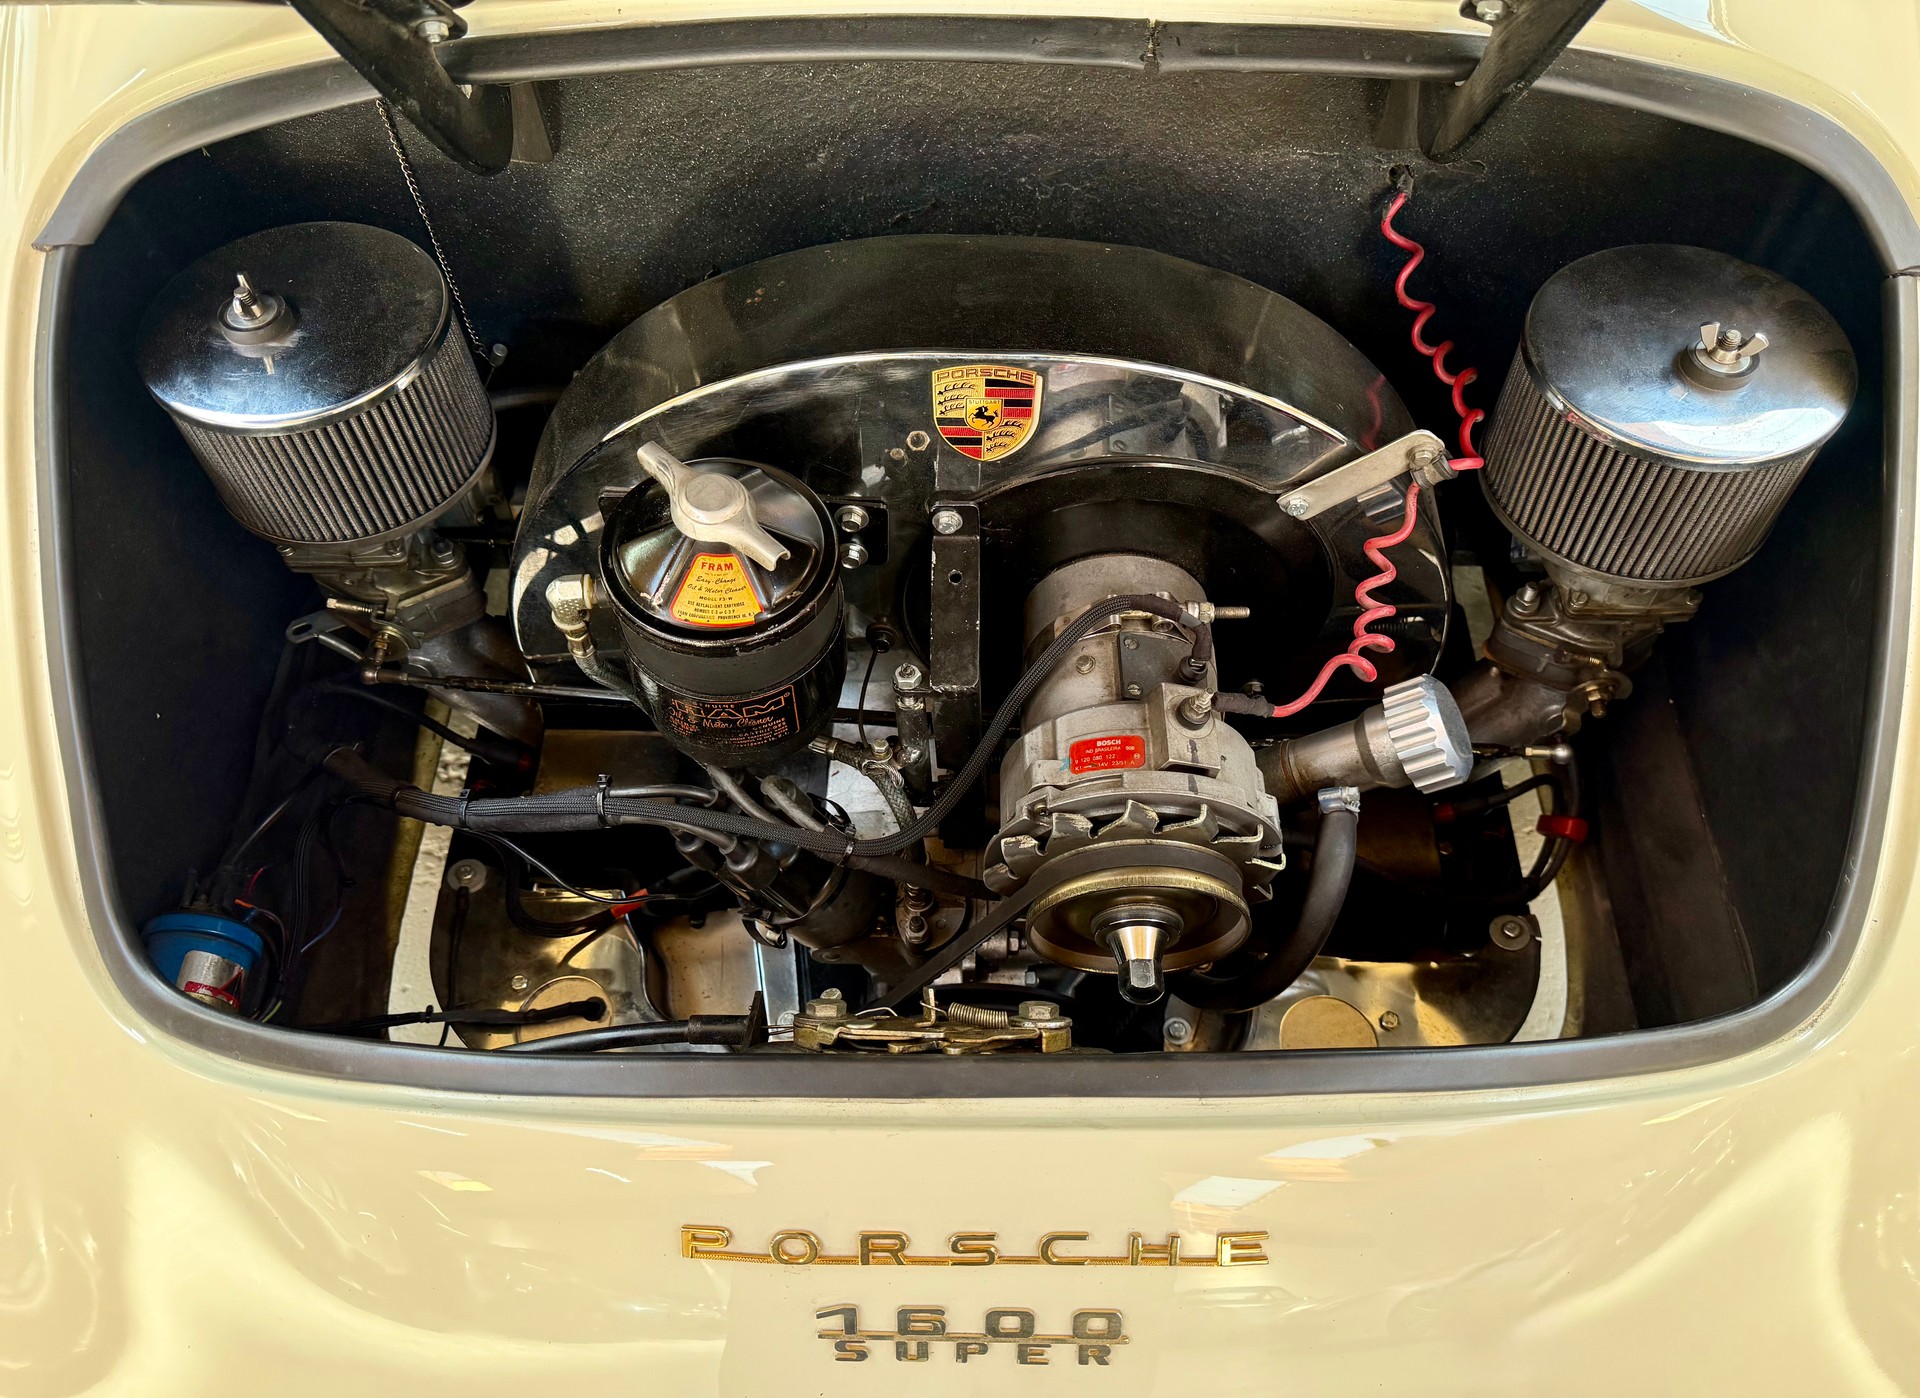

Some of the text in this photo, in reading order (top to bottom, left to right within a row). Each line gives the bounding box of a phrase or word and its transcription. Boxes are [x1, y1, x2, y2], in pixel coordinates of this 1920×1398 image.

[937, 368, 1034, 383] PORSCHE
[701, 562, 734, 571] FRAM
[724, 585, 747, 594] Cleaner
[681, 1225, 1269, 1265] PORSCHE
[816, 1303, 1124, 1341] 1600
[834, 1340, 1112, 1366] SUPER
